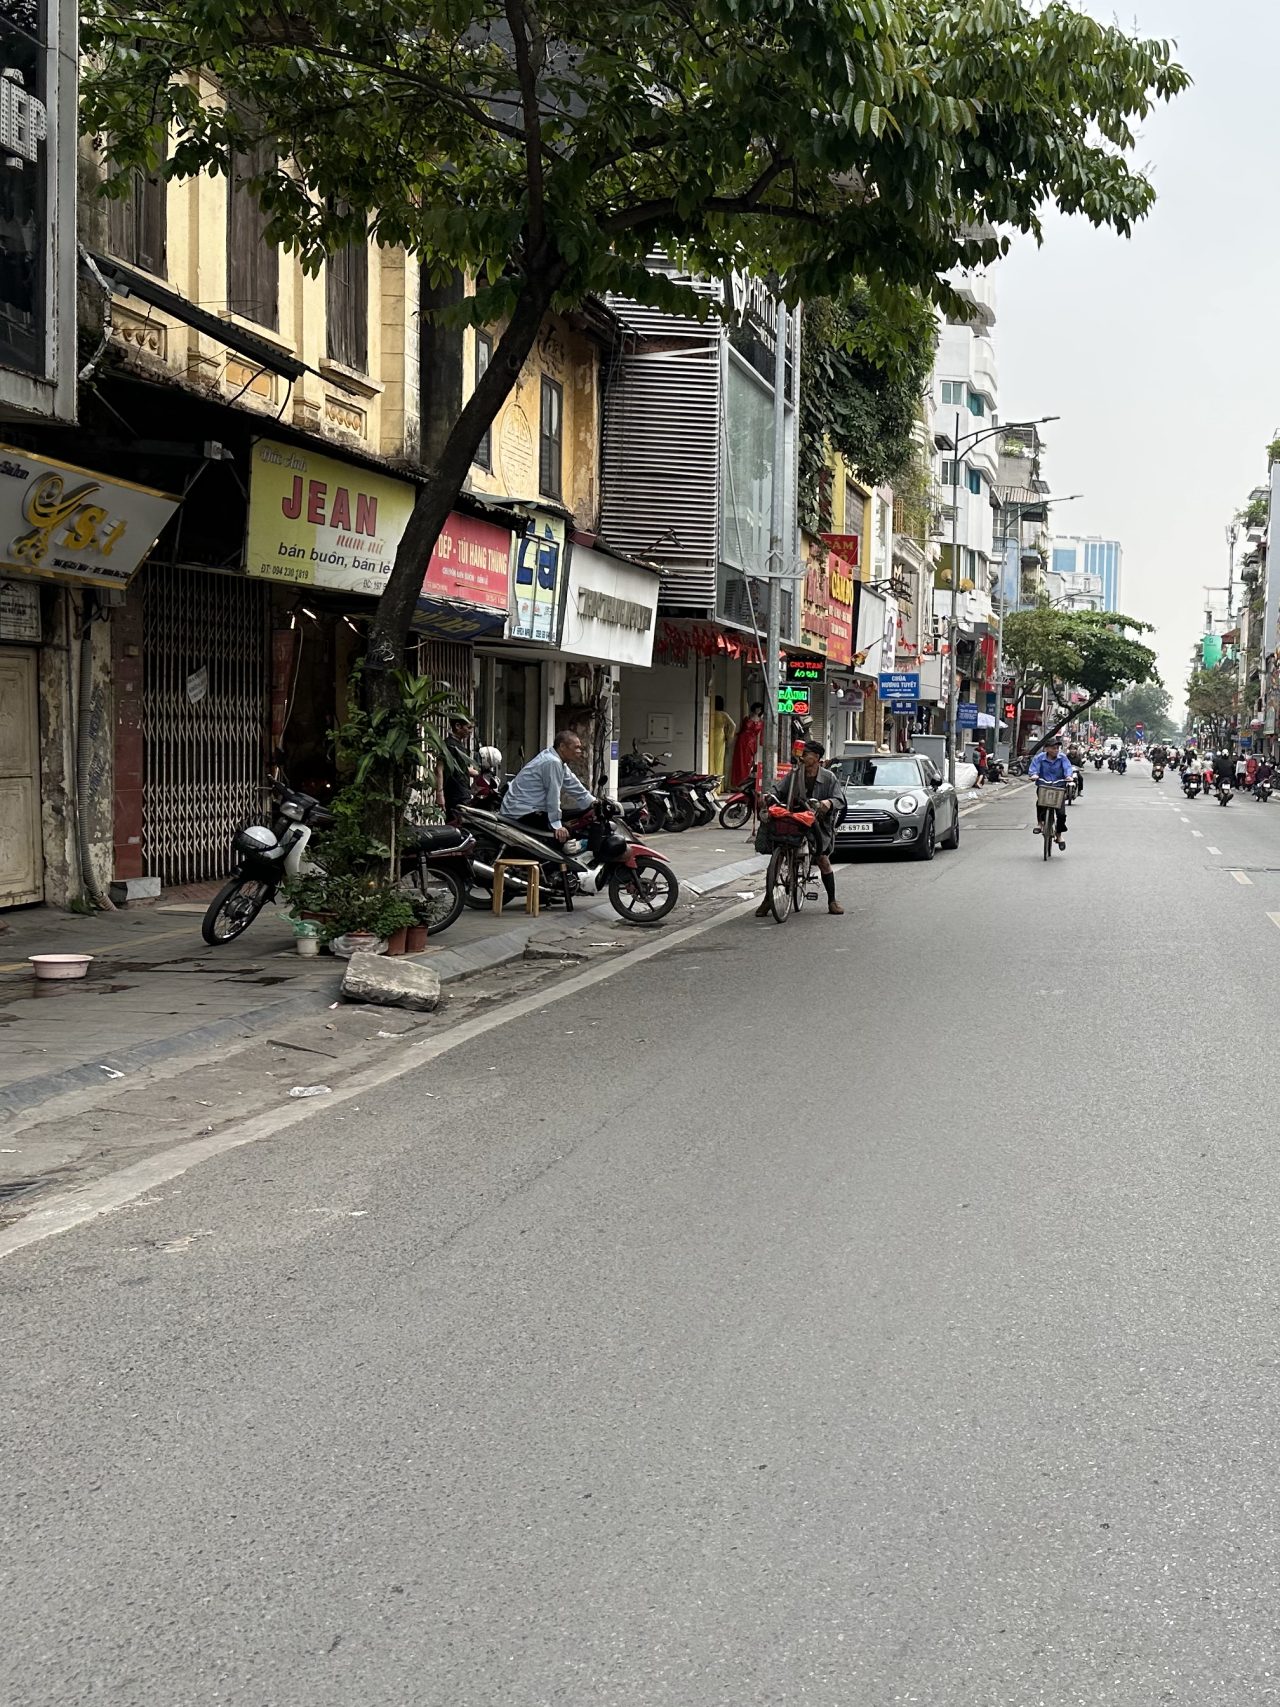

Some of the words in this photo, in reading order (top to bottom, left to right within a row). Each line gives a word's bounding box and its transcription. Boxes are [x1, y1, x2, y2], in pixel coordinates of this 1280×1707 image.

[282, 475, 378, 537] JEAN
[278, 542, 306, 559] bán
[310, 550, 348, 568] buôn,
[352, 556, 376, 572] bán
[336, 535, 364, 551] nam
[438, 531, 453, 559] DÉP
